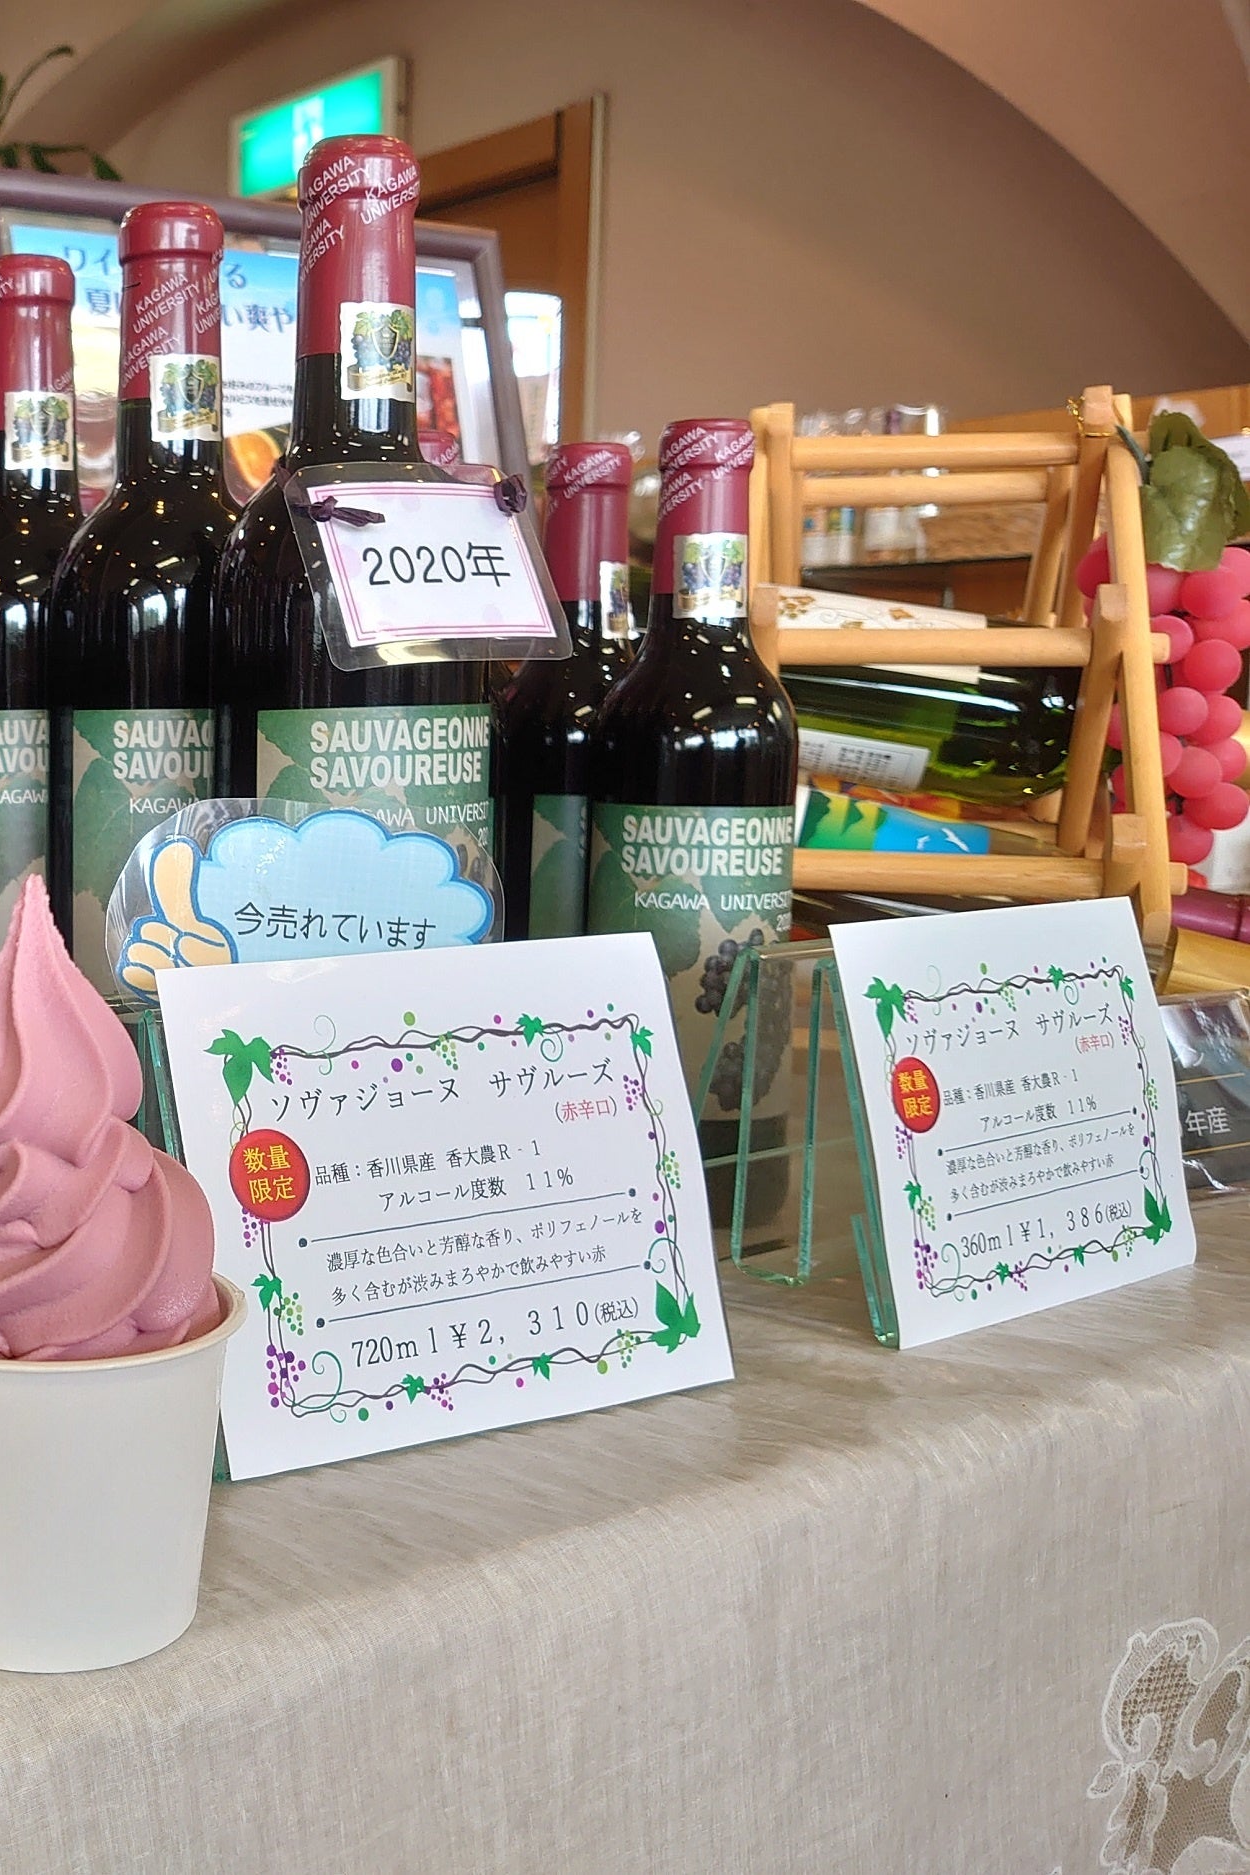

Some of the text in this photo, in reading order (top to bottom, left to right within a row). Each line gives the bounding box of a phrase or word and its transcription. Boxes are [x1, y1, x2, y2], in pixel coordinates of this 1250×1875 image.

[133, 280, 200, 334] UNIVERSITY
[134, 273, 188, 315] KAGAWA
[562, 449, 614, 483] KAGAWA
[362, 541, 510, 587] 2020年
[309, 716, 490, 754] SAUVAGEONNE
[309, 751, 481, 789] SAVOUREUSE
[622, 814, 793, 846] SAUVAGEONNE
[621, 846, 783, 877] SAVOUREUSE
[634, 890, 710, 911] KAGAWA
[234, 901, 438, 950] 今売れています
[904, 1003, 1114, 1056] ソヴァジョーヌ サヴルーズ
[269, 1055, 616, 1123] ソヴァジョーヌ サヴルーズ
[897, 1069, 927, 1094] 数量
[554, 1098, 619, 1125] (赤辛口)
[901, 1096, 933, 1119] 限定
[979, 1102, 1056, 1132] アルコール度数
[1179, 1106, 1231, 1137] 年産
[242, 1143, 292, 1172] 数量
[248, 1176, 296, 1204] 限定
[379, 1168, 575, 1213] アルコール度数 11%
[331, 1245, 607, 1307] 多く含むが渋みまろやかで飲みやすい赤
